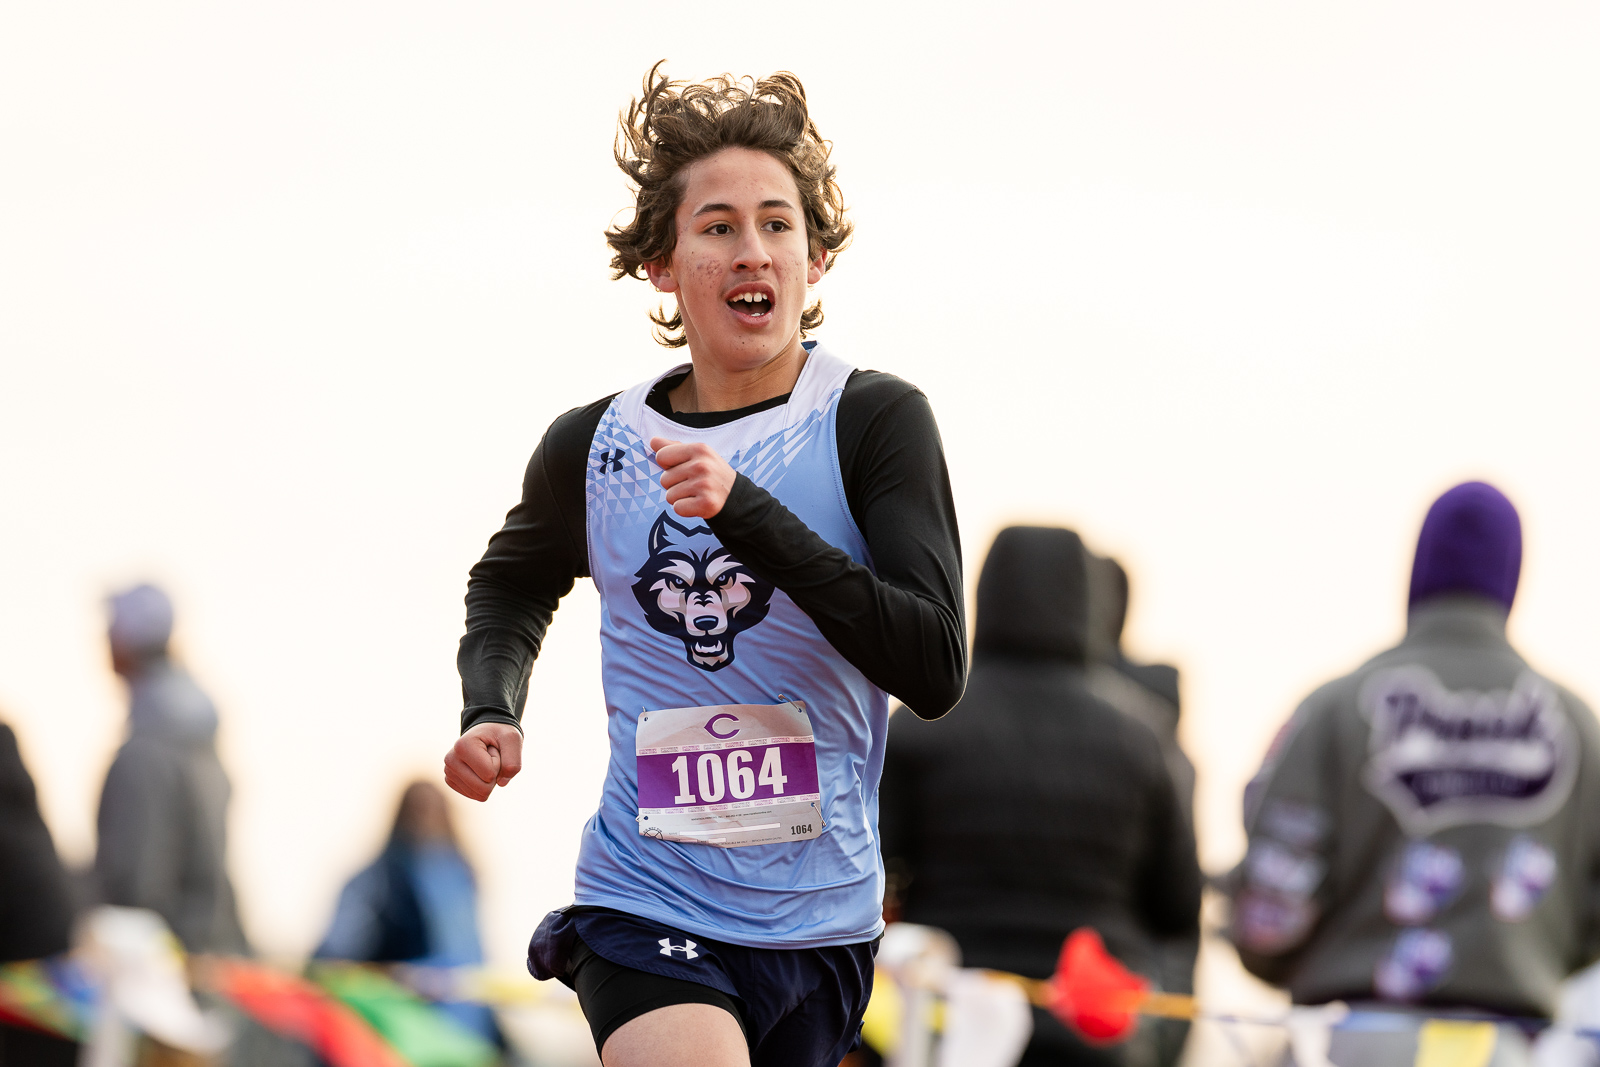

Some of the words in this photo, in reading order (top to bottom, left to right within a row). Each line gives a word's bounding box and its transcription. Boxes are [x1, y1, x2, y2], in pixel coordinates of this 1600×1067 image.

[703, 713, 740, 740] C
[671, 746, 788, 805] 1064
[790, 823, 813, 836] 1064
